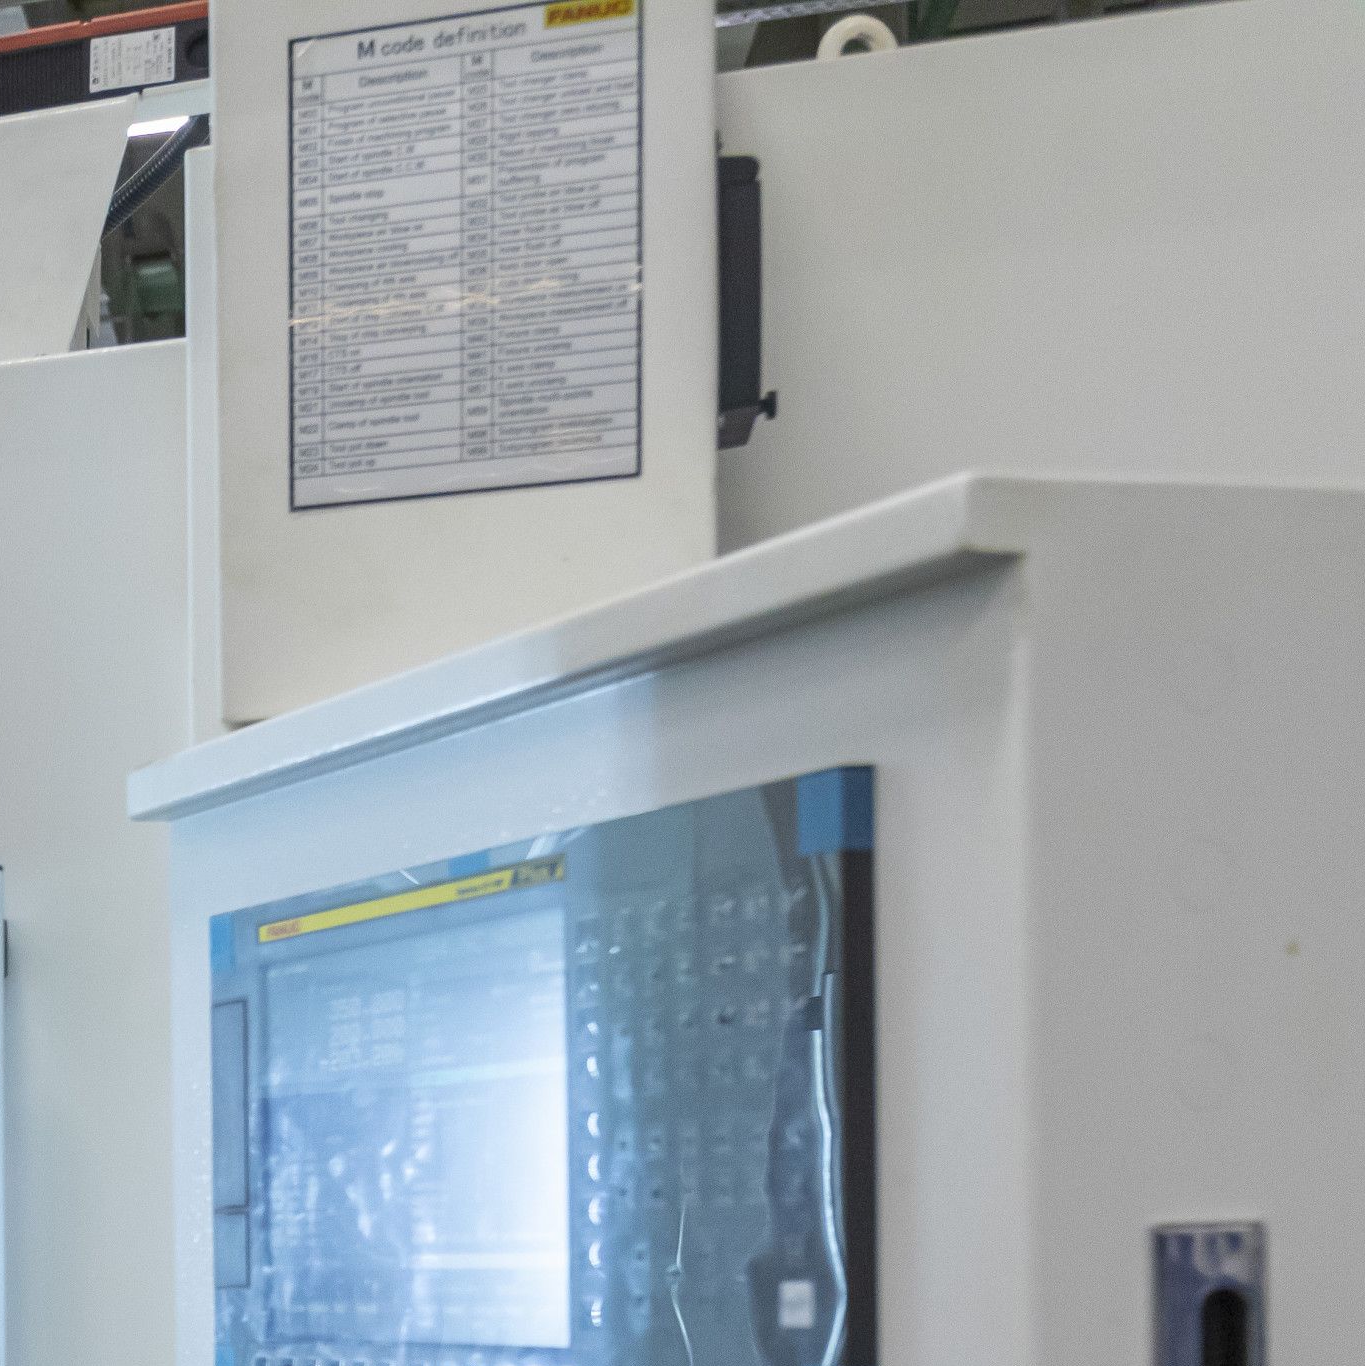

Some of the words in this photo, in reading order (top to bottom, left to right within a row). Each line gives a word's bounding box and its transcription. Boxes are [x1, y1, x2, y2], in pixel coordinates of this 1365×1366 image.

[358, 39, 374, 59] M
[380, 34, 424, 56] code
[433, 17, 525, 48] definition
